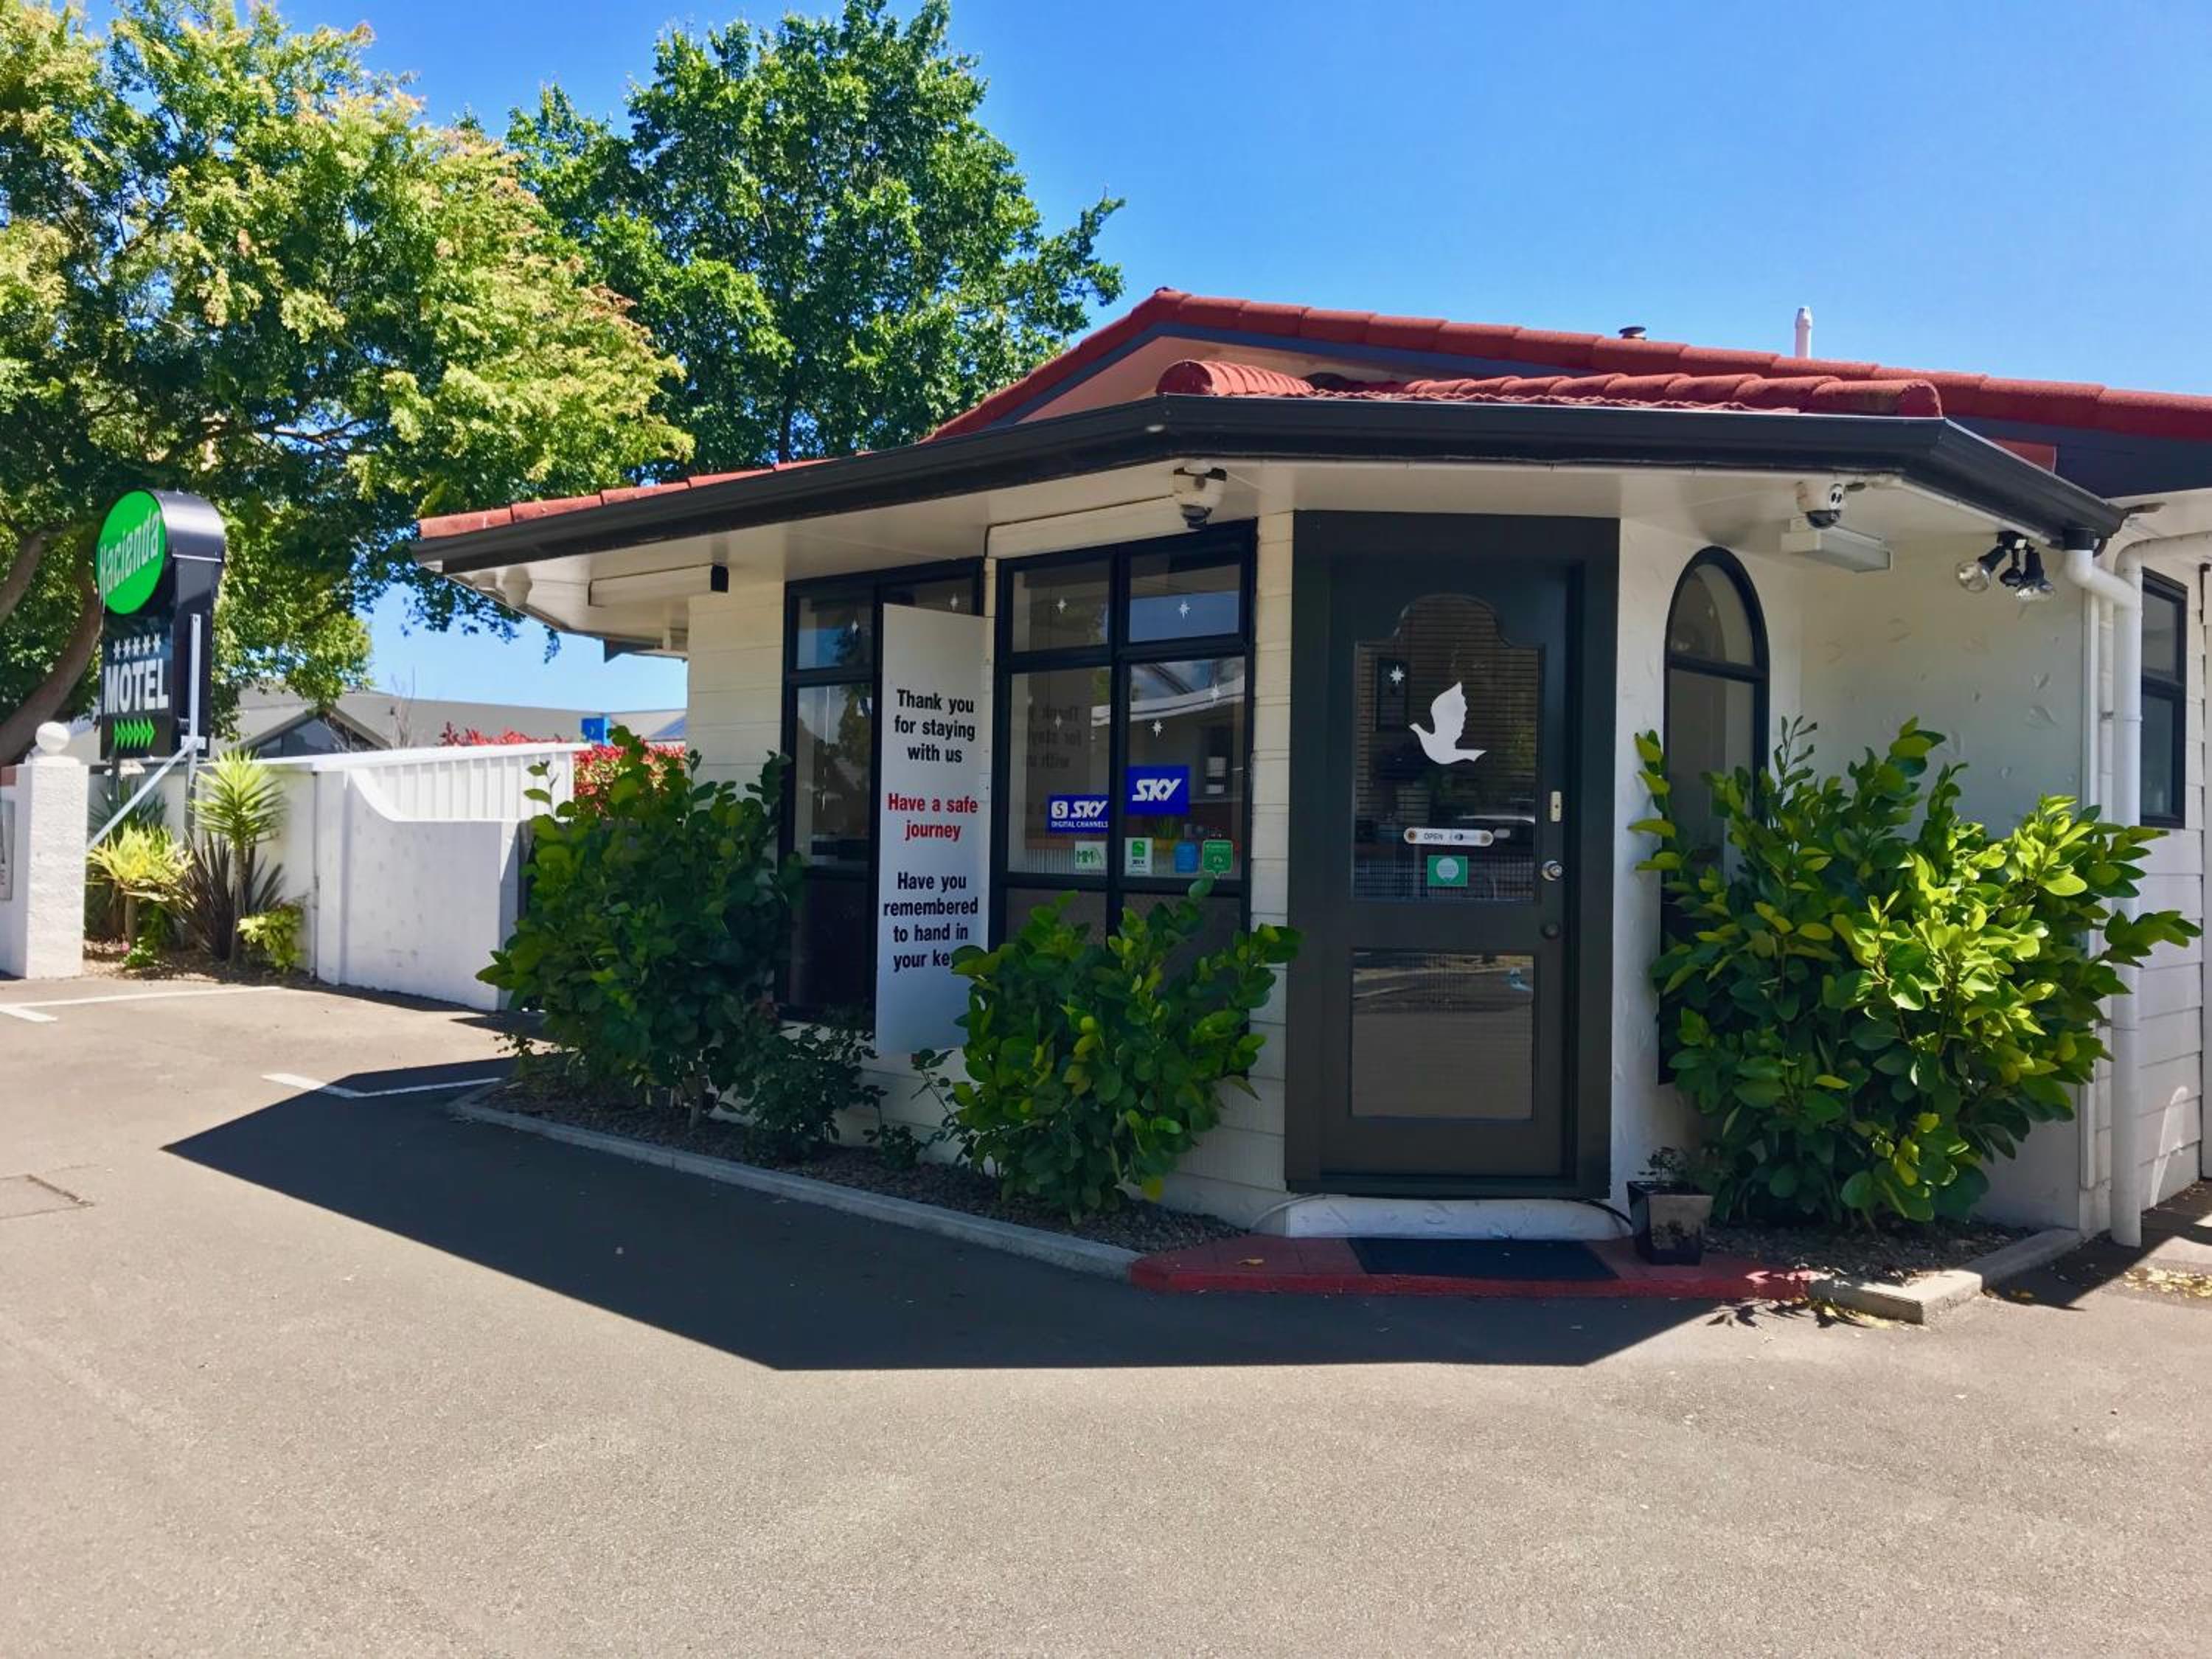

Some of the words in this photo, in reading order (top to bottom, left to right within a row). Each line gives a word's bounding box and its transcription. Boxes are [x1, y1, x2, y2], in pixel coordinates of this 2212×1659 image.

[99, 507, 160, 602] Hacienda
[105, 658, 169, 714] MOTEL
[897, 688, 942, 710] Thank
[948, 698, 974, 715] you
[894, 714, 917, 734] for
[922, 719, 975, 742] staying
[907, 743, 940, 761] with
[945, 749, 963, 762] us
[1132, 778, 1183, 801] SKY
[888, 793, 925, 812] Have
[931, 798, 941, 812] a
[946, 796, 978, 813] safe
[1070, 801, 1108, 818] SKY
[905, 820, 961, 842] journey
[897, 872, 934, 889] Have
[941, 876, 967, 893] you
[883, 897, 978, 916] remembered
[893, 925, 908, 942] to
[914, 922, 950, 941] hand
[956, 922, 968, 940] in
[893, 954, 928, 973] your
